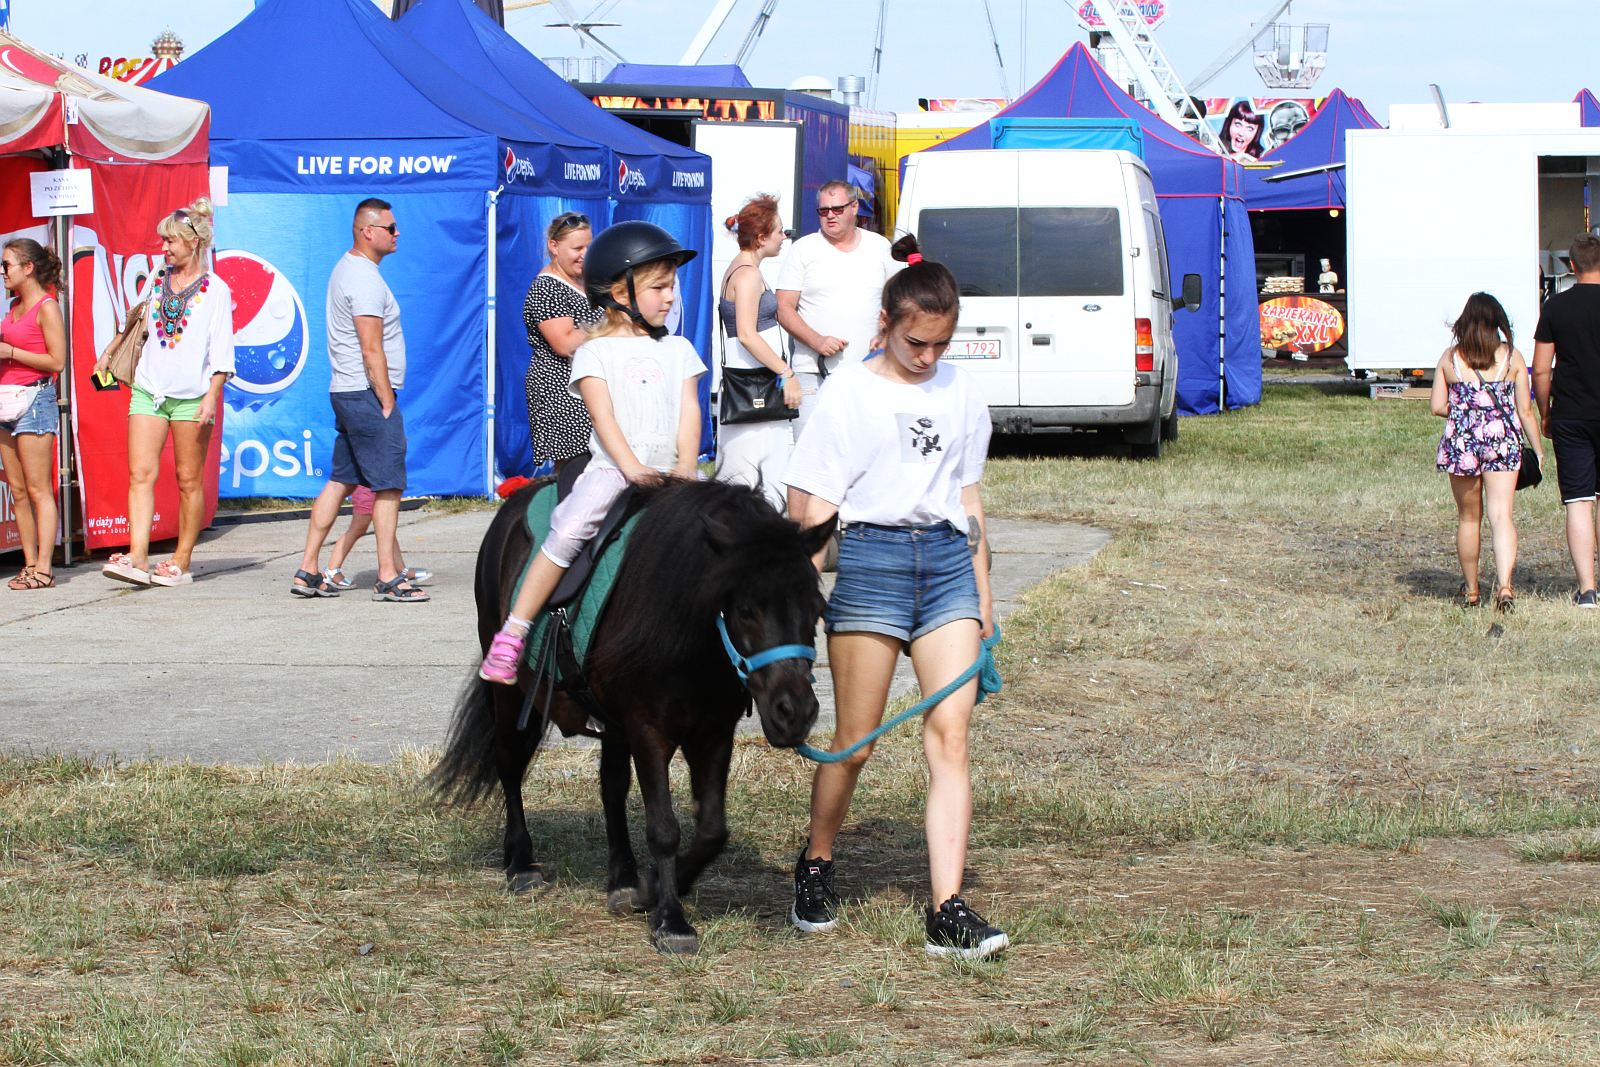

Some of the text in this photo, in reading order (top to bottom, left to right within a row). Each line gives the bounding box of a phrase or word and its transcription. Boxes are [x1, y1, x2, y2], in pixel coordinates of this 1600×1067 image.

[298, 155, 453, 174] LIVE FOR NOW
[514, 157, 536, 181] pepsi
[564, 162, 601, 181] LIVE FOR NOW
[627, 164, 647, 190] pepsi
[672, 171, 705, 188] LIVE FOR NOW
[1261, 304, 1339, 328] ZAPIEKANKA
[1294, 324, 1330, 344] XXL
[965, 342, 996, 355] 1792
[114, 515, 127, 525] nie
